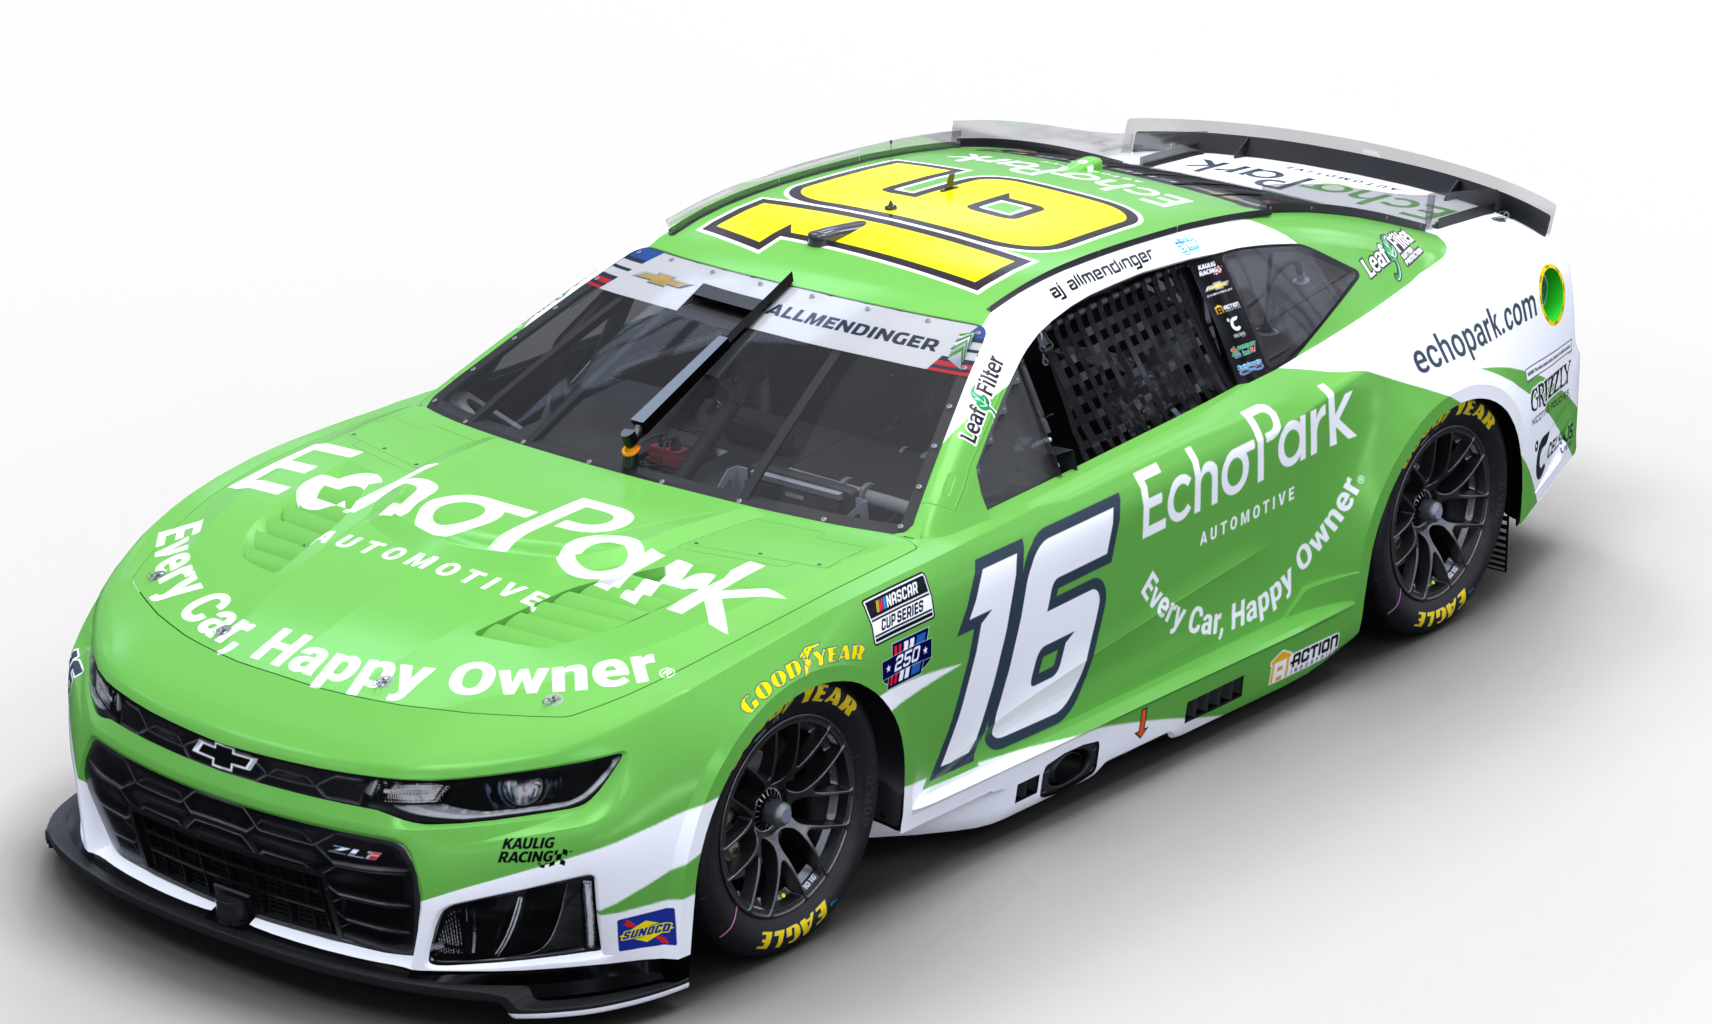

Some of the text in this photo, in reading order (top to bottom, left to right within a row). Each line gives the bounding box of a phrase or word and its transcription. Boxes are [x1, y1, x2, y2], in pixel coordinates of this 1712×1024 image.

[698, 161, 1142, 291] 16
[1049, 249, 1152, 300] aj allmendinger
[765, 304, 940, 352] ALLMENDINGER
[1413, 295, 1538, 373] echopark.com
[960, 355, 1004, 444] Leaf Filter
[1531, 359, 1571, 412] GRIZZLY
[1133, 383, 1358, 540] EchoPark
[228, 443, 786, 634] EchoPark
[1200, 486, 1296, 546] AUTOMOTIVE
[309, 530, 549, 612] AUTOMOTIVE
[885, 581, 919, 609] NASCAR
[149, 519, 204, 602] Every
[250, 627, 437, 701] Happy
[881, 600, 924, 631] CUP SERIES
[1141, 570, 1187, 635] Every
[1188, 606, 1224, 641] Car,
[1231, 567, 1292, 630] Happy
[1413, 588, 1467, 628] EAGLE
[894, 645, 922, 673] 250
[931, 493, 1121, 779] 16
[1290, 633, 1339, 668] ACTION
[498, 850, 554, 863] RACING
[502, 837, 555, 850] KAULIG
[621, 923, 673, 941] SUNOCO
[756, 899, 828, 950] EAGLE
